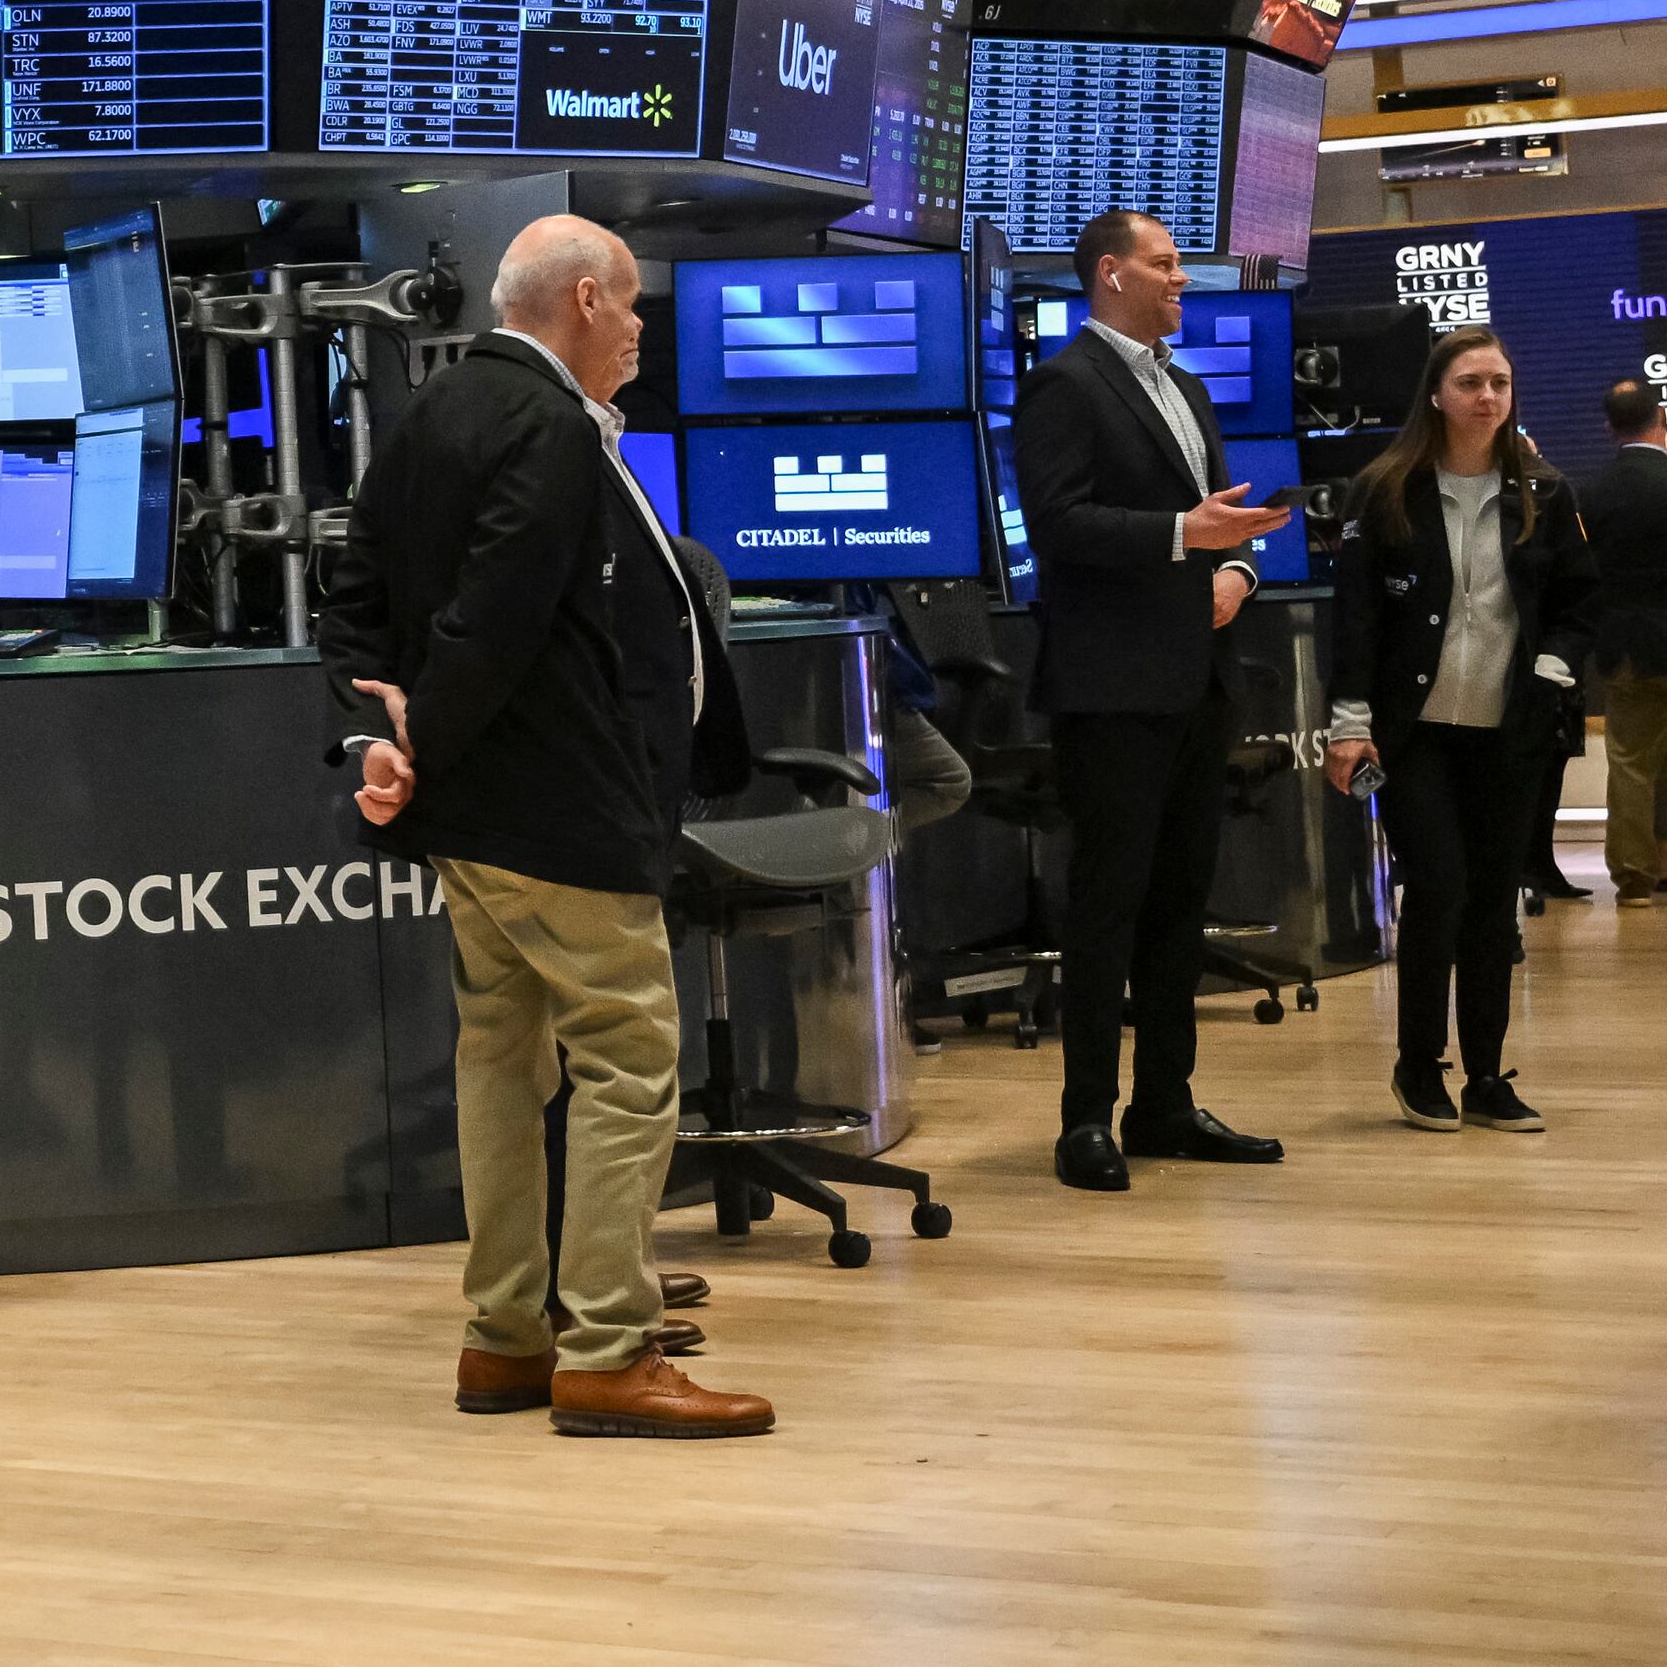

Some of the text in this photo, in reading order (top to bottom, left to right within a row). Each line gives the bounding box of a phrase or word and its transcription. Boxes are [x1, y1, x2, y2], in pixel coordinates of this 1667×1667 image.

[12, 7, 131, 23] OLN 20.8900
[527, 11, 612, 24] WMT 93.2200
[12, 56, 131, 72] TRC 16.5600
[778, 18, 837, 96] Uber
[545, 88, 640, 119] Walmart
[13, 129, 132, 146] WPC 62.1700
[1395, 240, 1486, 271] GRNY
[1396, 271, 1489, 294] LISTED
[1398, 291, 1491, 325] YSE
[735, 526, 930, 548] CITADEL Securities
